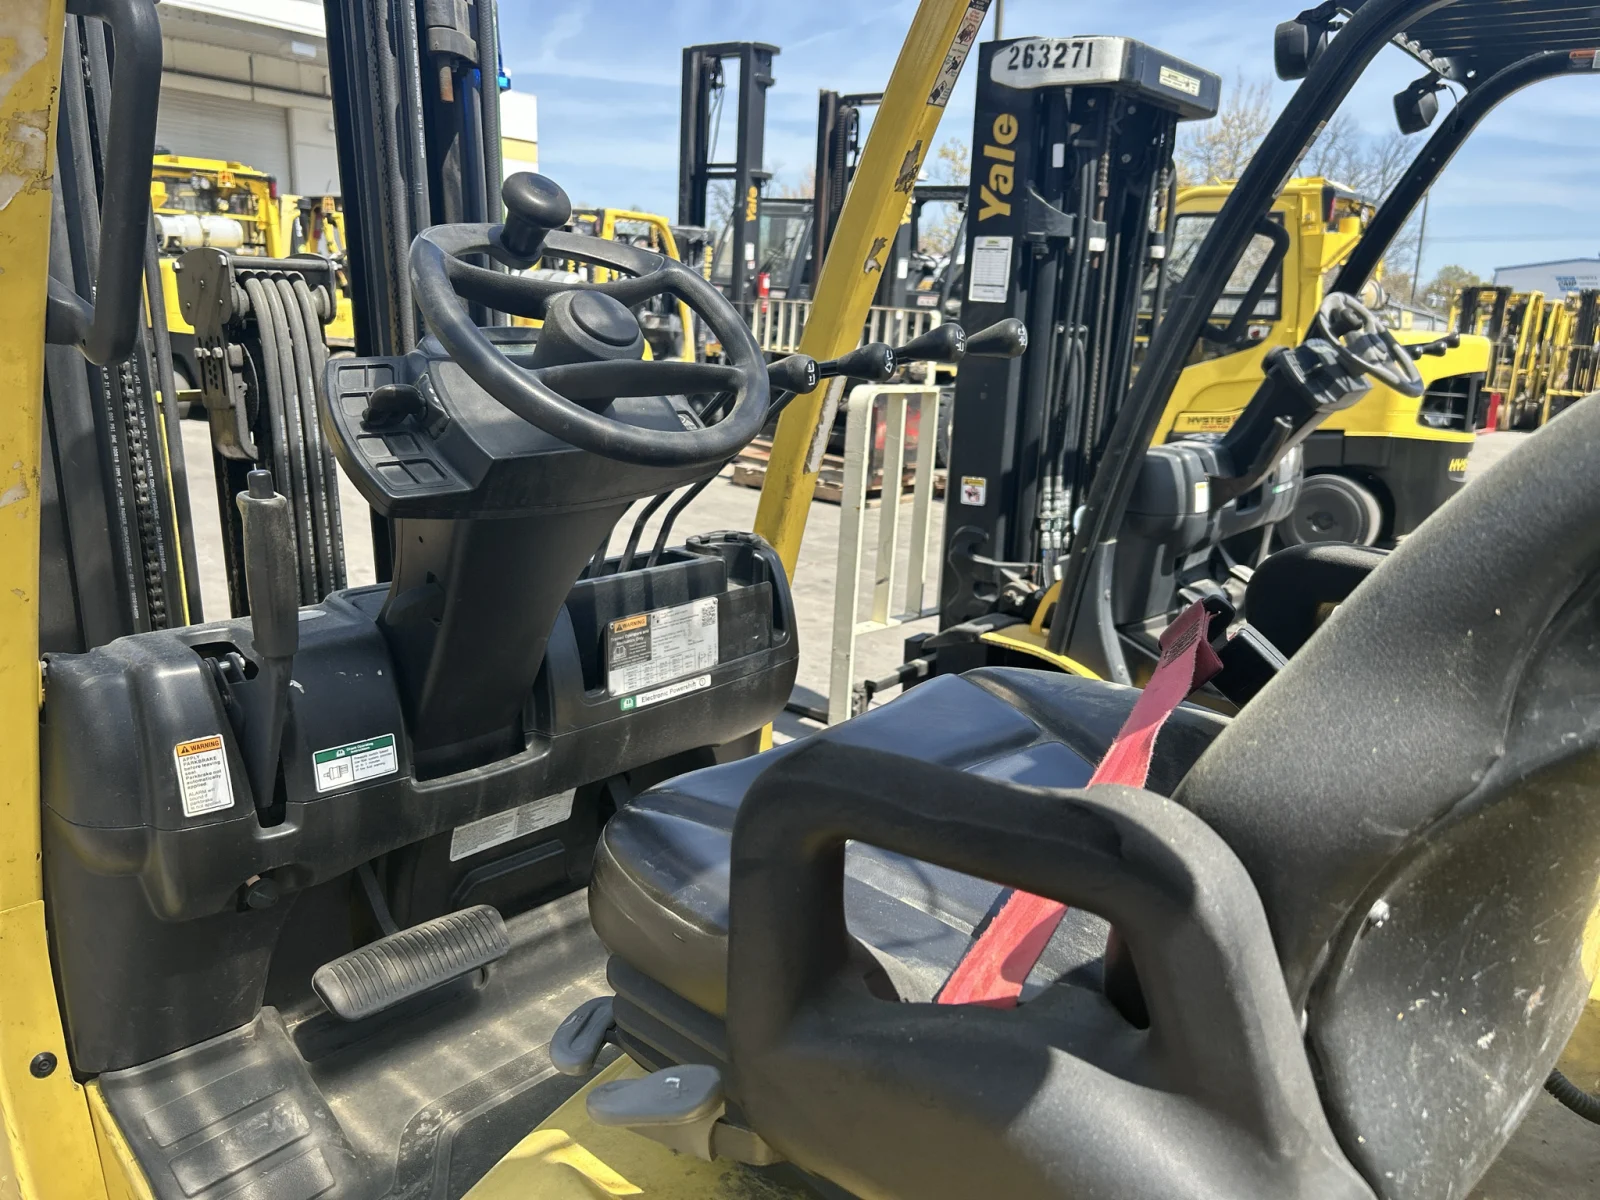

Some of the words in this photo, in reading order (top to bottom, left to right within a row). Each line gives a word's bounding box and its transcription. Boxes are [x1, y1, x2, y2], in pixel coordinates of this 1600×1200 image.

[1008, 42, 1093, 70] 263271
[978, 114, 1018, 222] Yale
[746, 186, 757, 221] Yale
[1448, 458, 1468, 472] HYS
[622, 619, 645, 629] WARNING
[642, 690, 668, 703] Electronic
[670, 682, 696, 694] Powershift
[190, 741, 219, 751] WARNING
[183, 756, 216, 766] PARKBRAKE
[202, 760, 220, 768] leaving
[186, 772, 212, 780] Parkbrake
[187, 775, 221, 785] automatically
